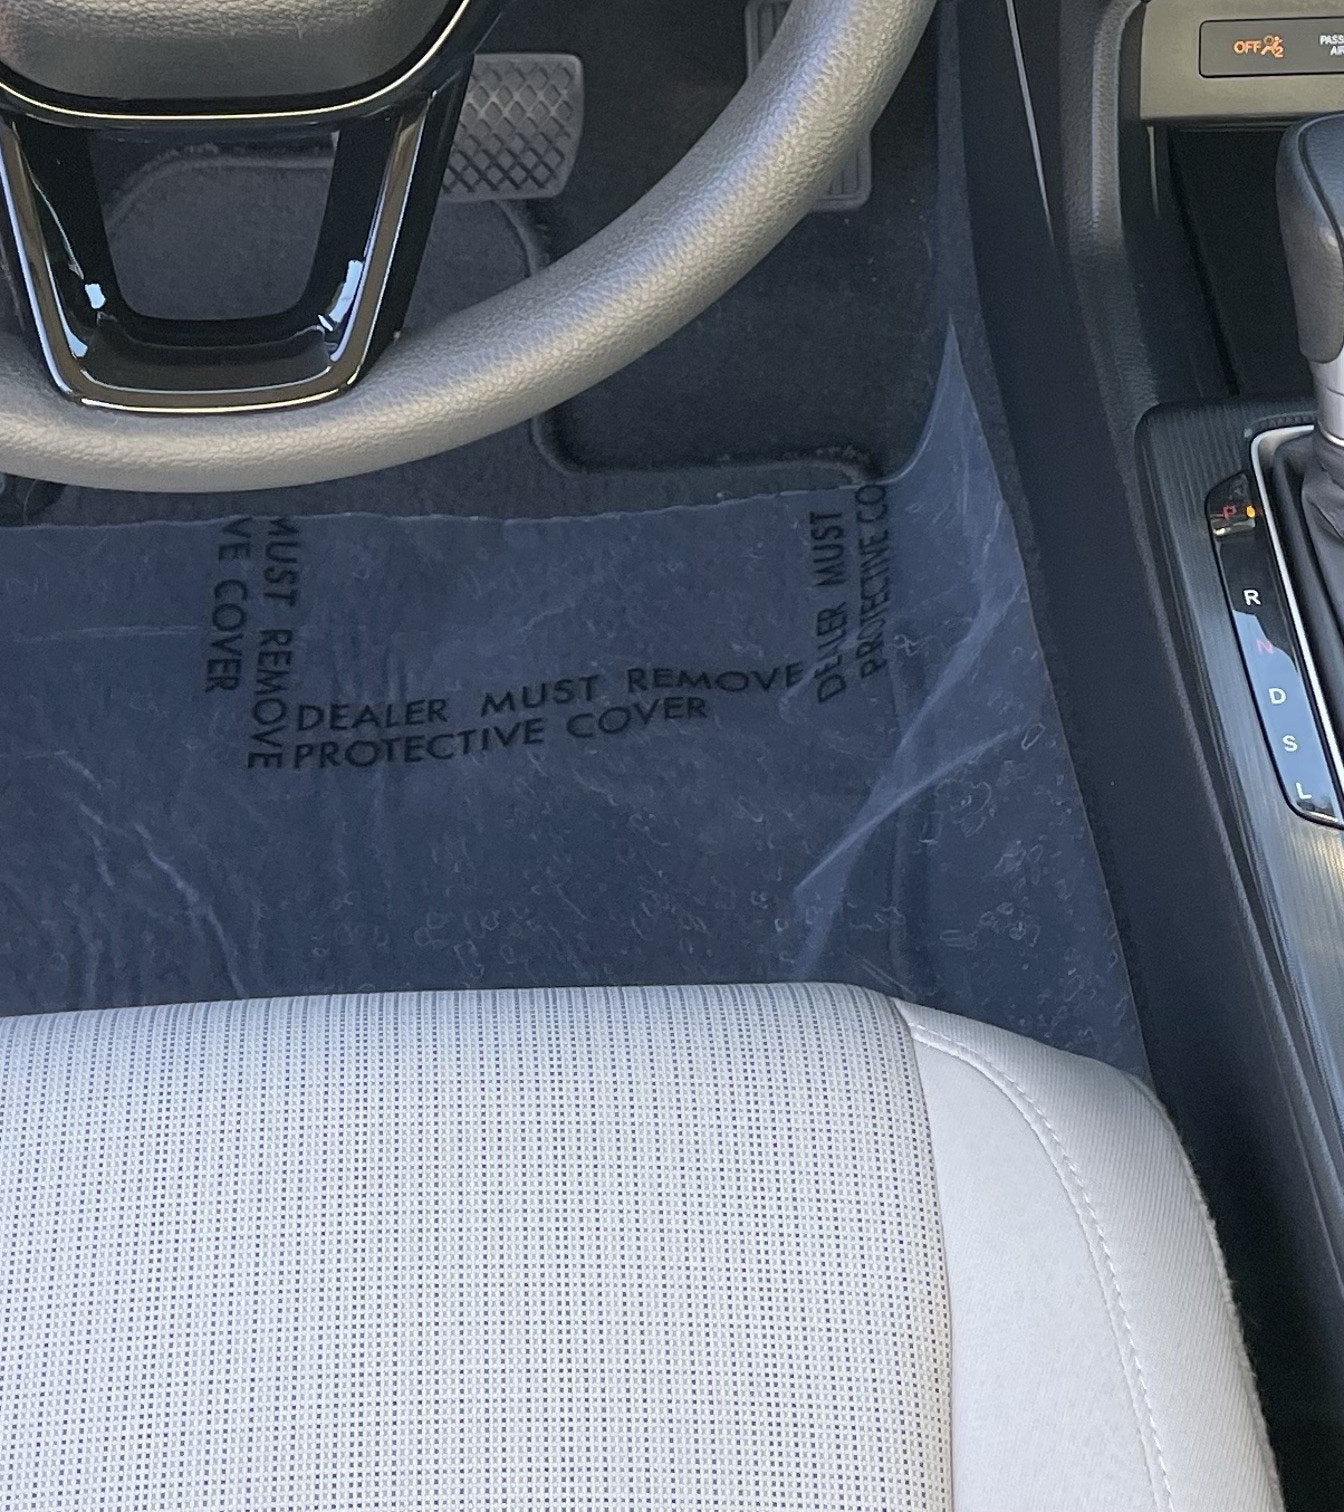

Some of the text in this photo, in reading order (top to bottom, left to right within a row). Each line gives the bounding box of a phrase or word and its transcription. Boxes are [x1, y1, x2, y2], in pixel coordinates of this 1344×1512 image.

[1233, 39, 1262, 55] OFF
[808, 510, 848, 589] MUST
[1244, 589, 1261, 606] R
[205, 578, 249, 694] COVER
[246, 627, 295, 770] REMOVE
[295, 659, 809, 733] DEALER MUST REMOVE
[1269, 687, 1287, 704] D
[292, 694, 709, 772] PROTECTIVE COVER
[1282, 735, 1298, 753] S
[1296, 781, 1312, 800] L
